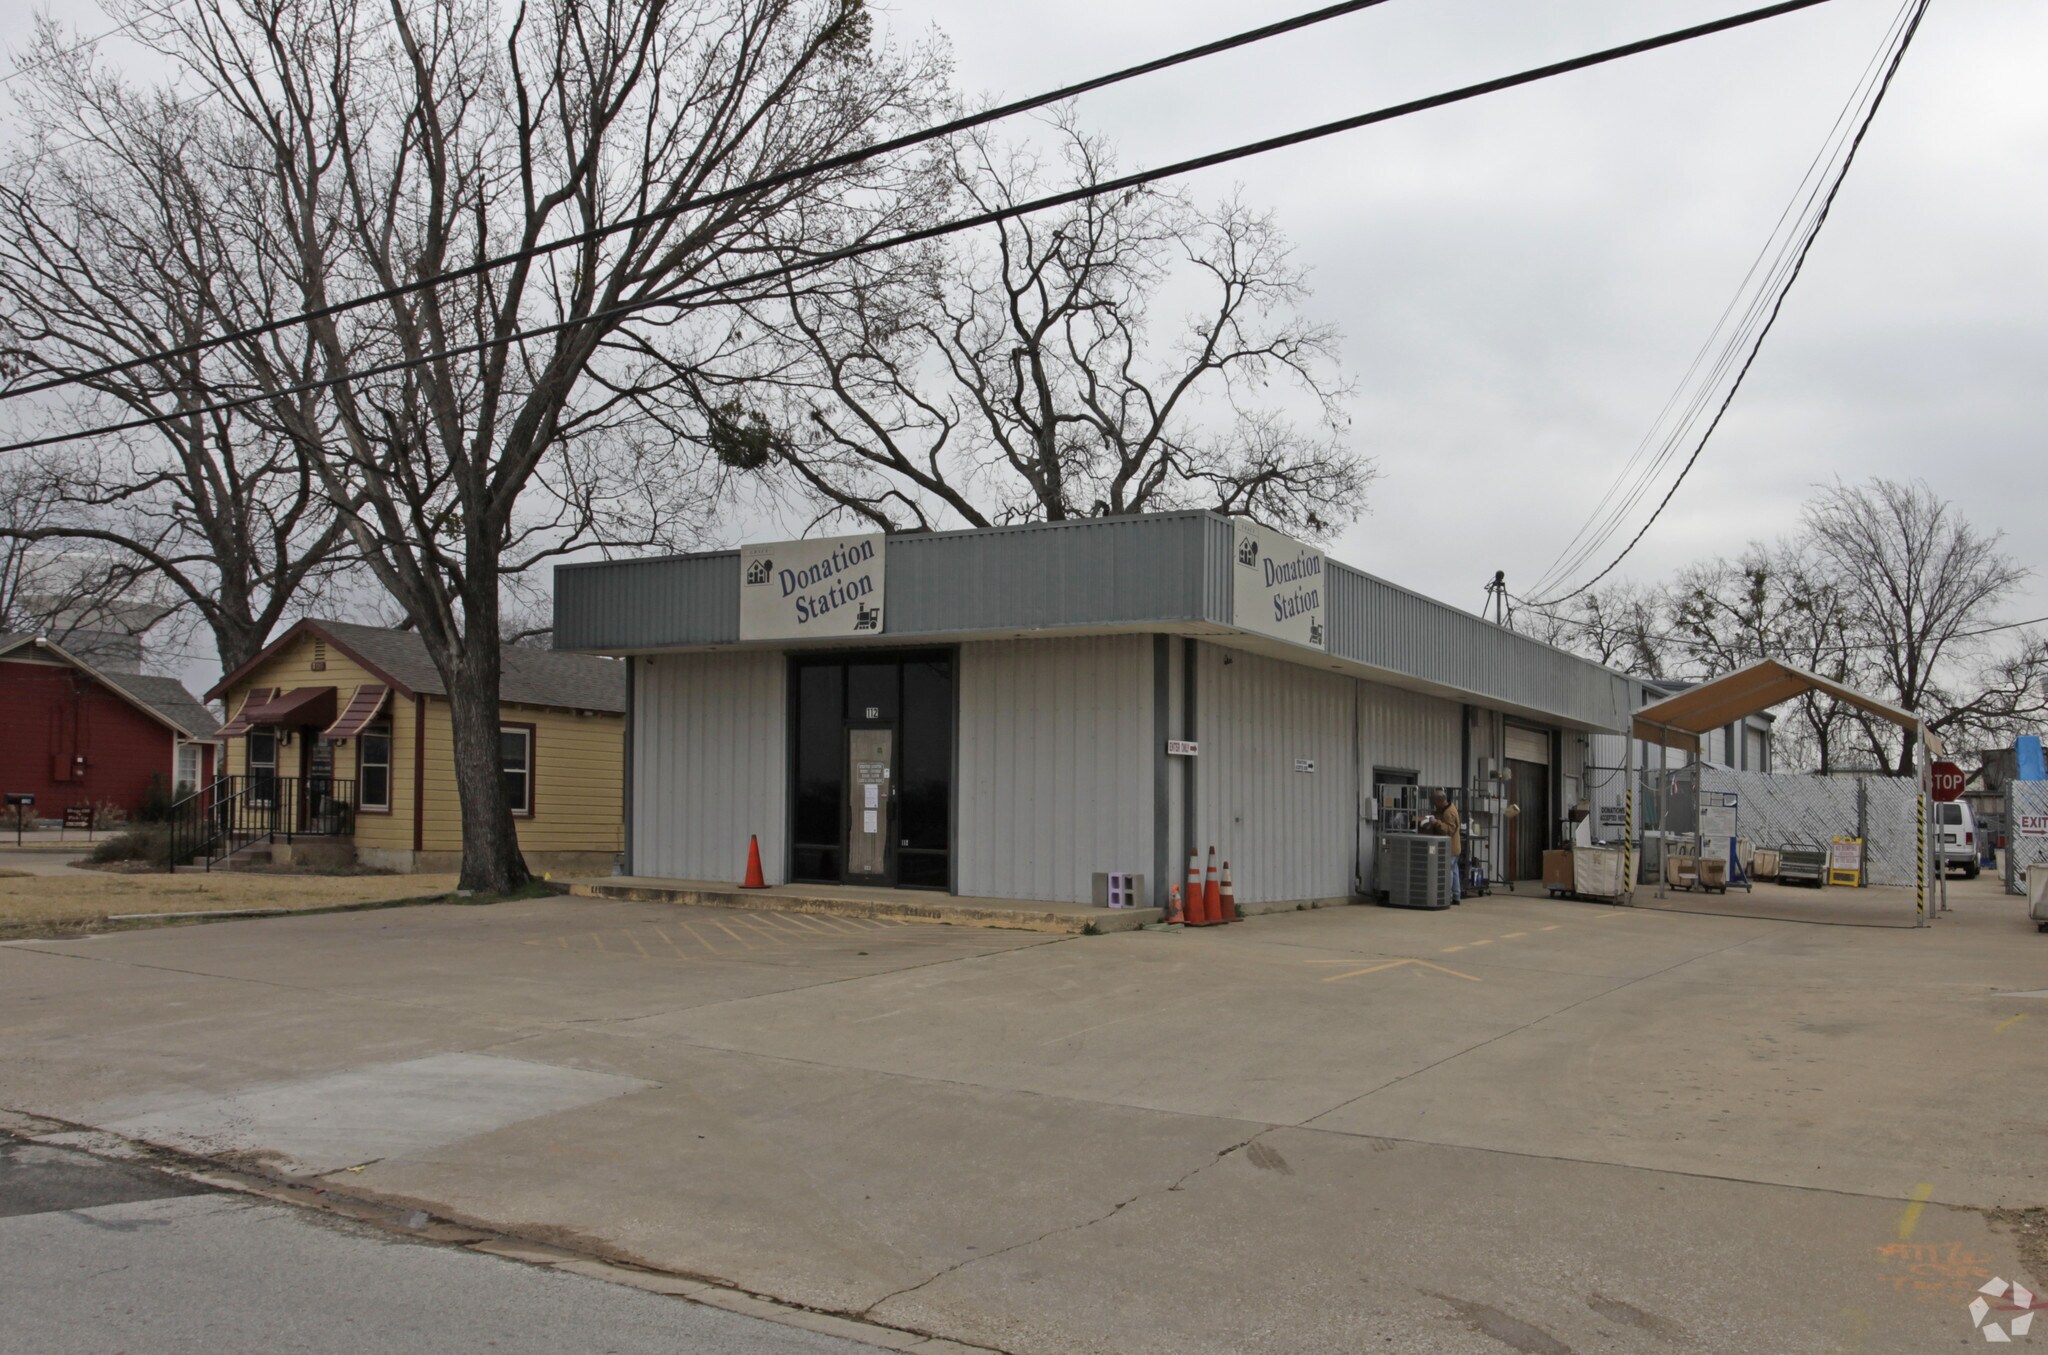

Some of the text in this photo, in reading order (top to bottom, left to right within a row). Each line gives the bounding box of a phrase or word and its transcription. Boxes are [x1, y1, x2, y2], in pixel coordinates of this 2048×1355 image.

[779, 540, 875, 597] Donation
[1263, 550, 1321, 587] Donation
[795, 574, 874, 624] Station
[1273, 585, 1320, 622] Station
[866, 707, 879, 718] 112
[1931, 774, 1962, 790] TOP
[2022, 816, 2048, 828] EXIT
